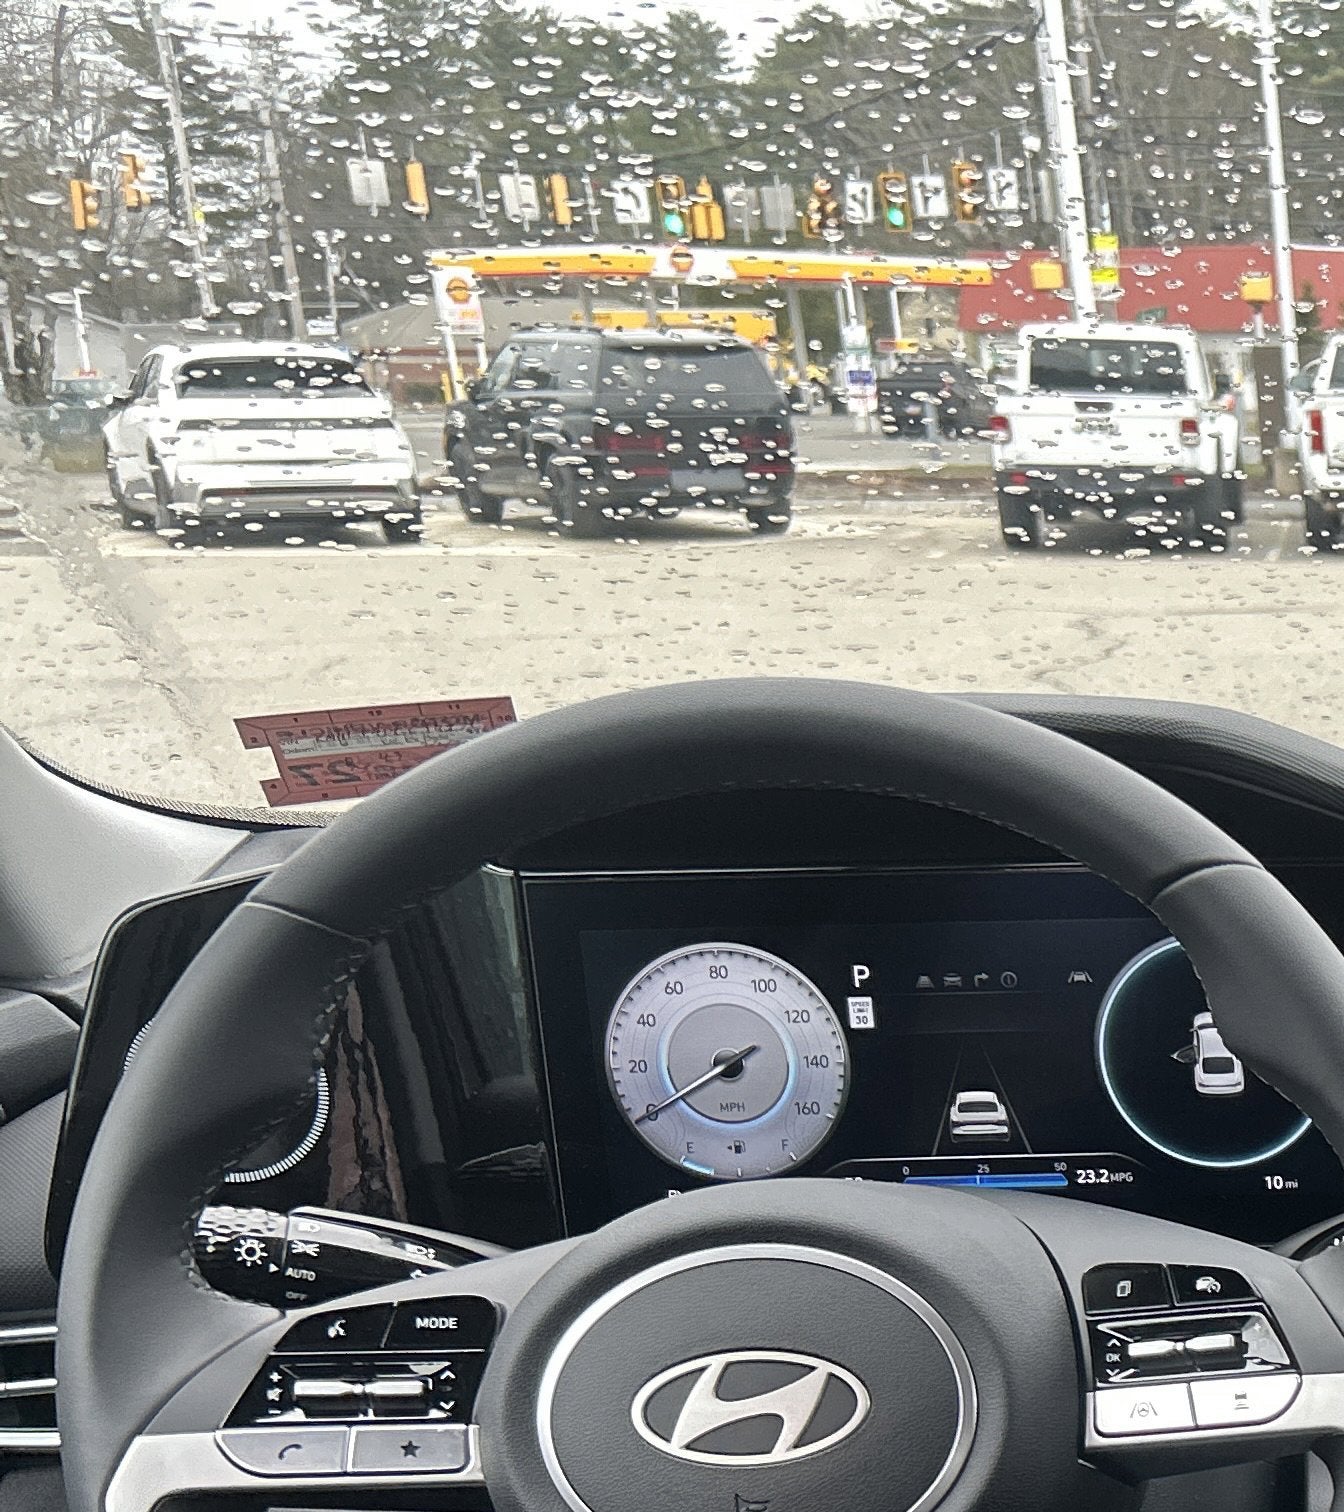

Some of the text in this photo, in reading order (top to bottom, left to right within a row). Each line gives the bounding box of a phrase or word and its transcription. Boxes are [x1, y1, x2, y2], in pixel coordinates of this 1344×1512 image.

[709, 966, 729, 980] 80
[853, 965, 870, 988] P
[664, 982, 684, 995] 60
[750, 979, 777, 993] 100
[637, 1014, 656, 1027] 40
[784, 1010, 810, 1024] 120
[856, 1015, 868, 1025] 30
[628, 1060, 648, 1073] 20
[803, 1055, 829, 1069] 140
[720, 1102, 745, 1113] MPH
[794, 1102, 820, 1116] 160
[686, 1142, 694, 1153] E
[781, 1140, 789, 1151] F
[902, 1166, 909, 1175] 0
[977, 1163, 990, 1174] 25
[1054, 1162, 1067, 1172] 50
[1077, 1168, 1133, 1184] 23.2 MPG
[1264, 1175, 1298, 1190] 10 mi
[285, 1266, 316, 1282] AUTO
[415, 1317, 458, 1330] MODE
[1105, 1351, 1122, 1363] OK
